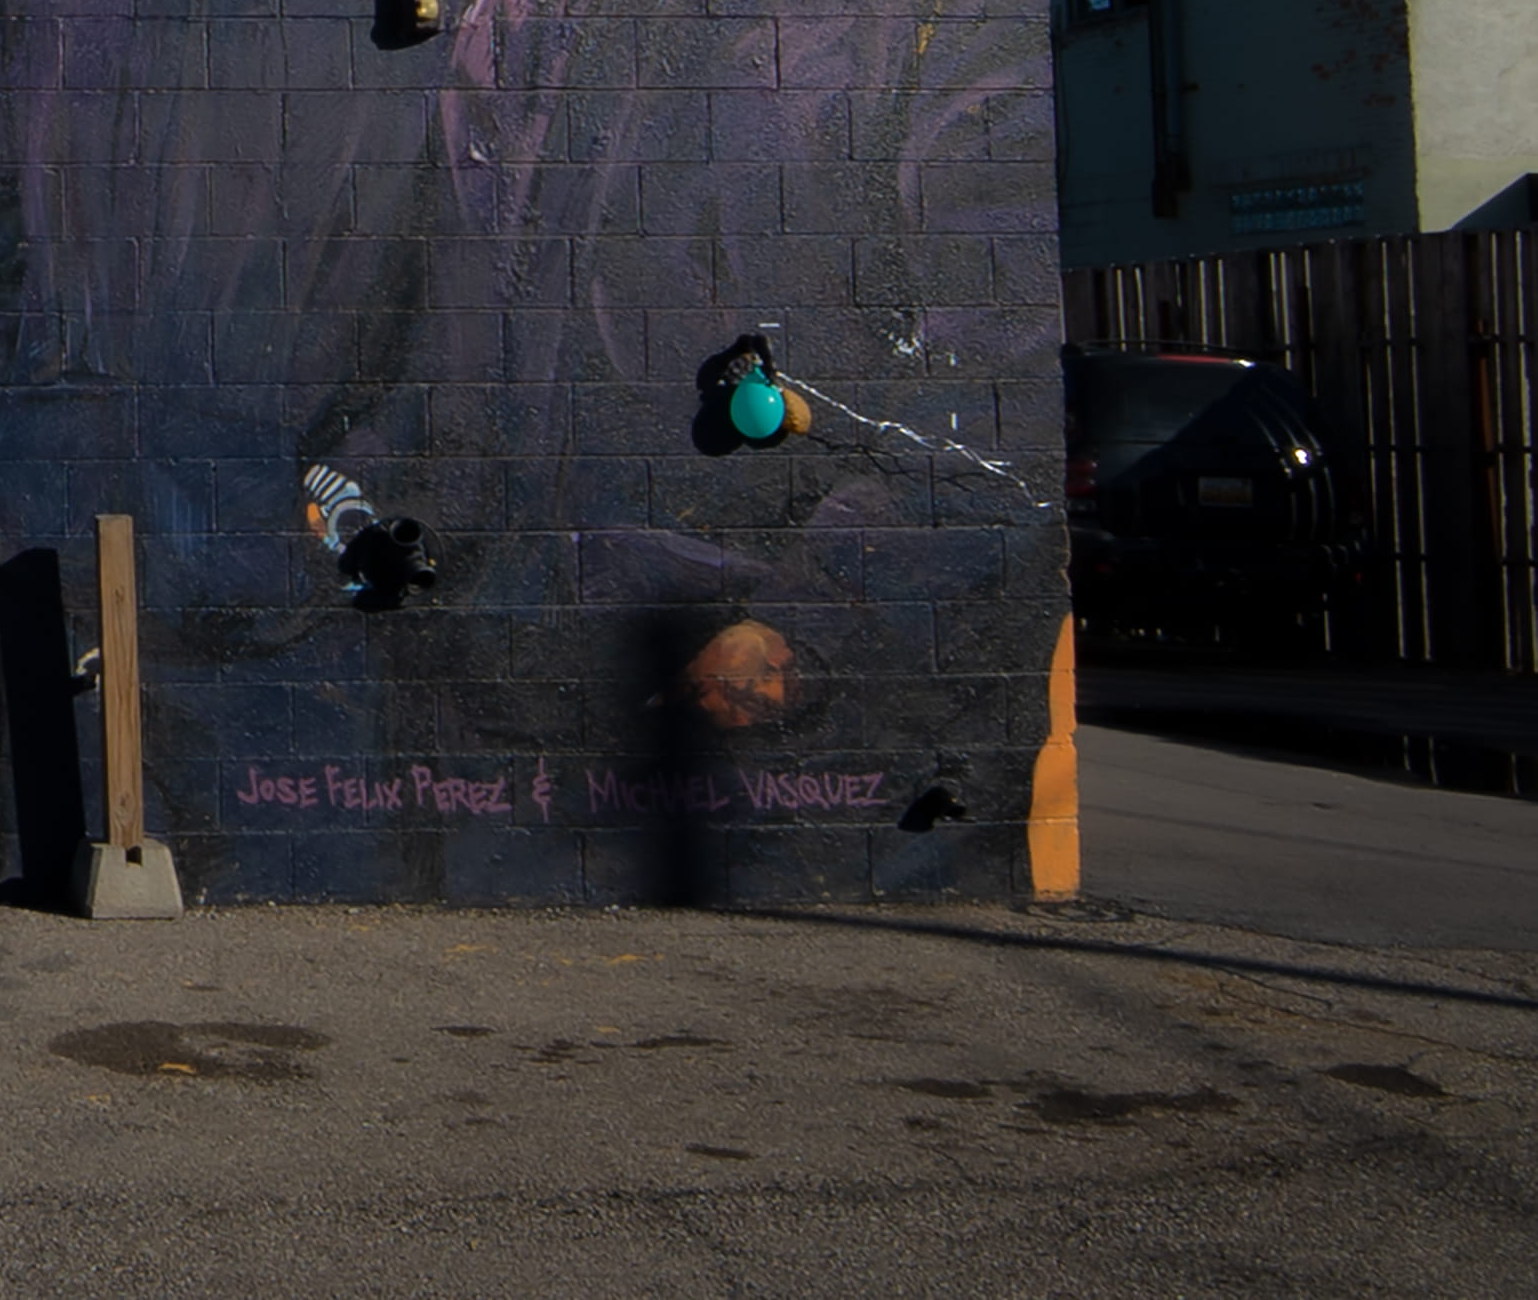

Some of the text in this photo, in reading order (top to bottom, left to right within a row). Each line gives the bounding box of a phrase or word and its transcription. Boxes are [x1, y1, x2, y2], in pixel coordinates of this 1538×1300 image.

[236, 757, 890, 823] JOSE FELIX PEREZ & MICHAEL VASQUEZ
